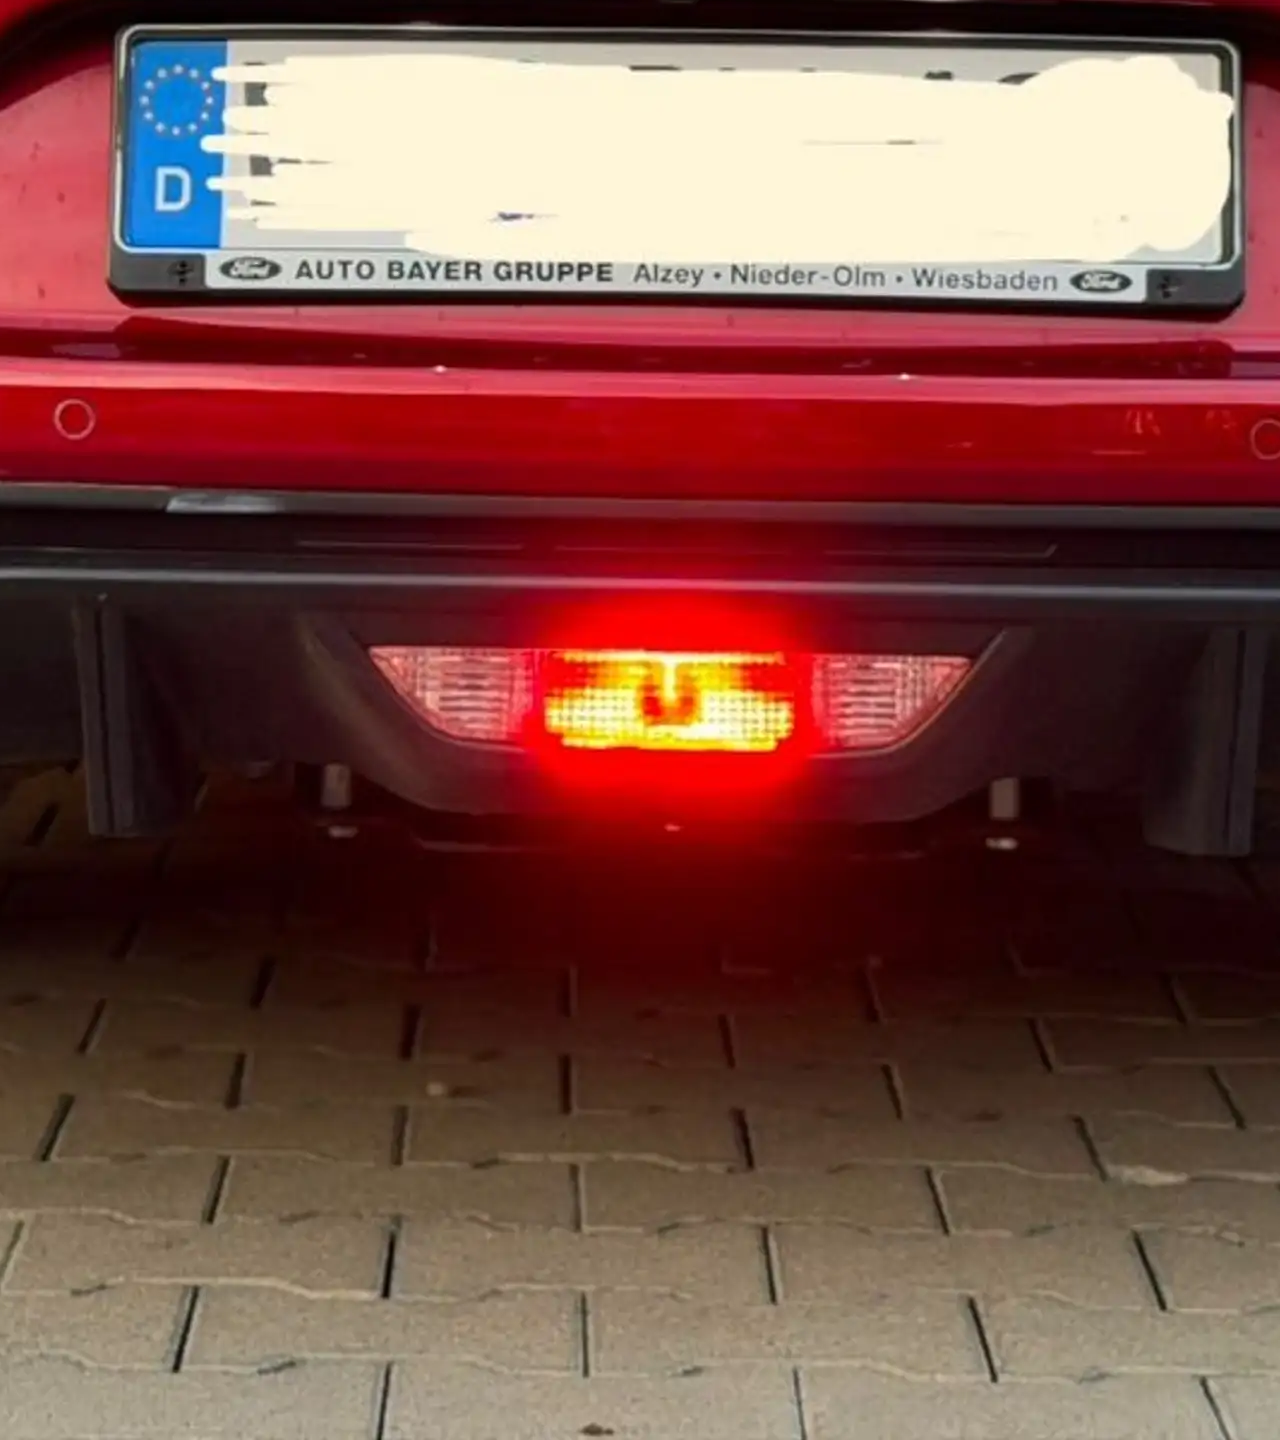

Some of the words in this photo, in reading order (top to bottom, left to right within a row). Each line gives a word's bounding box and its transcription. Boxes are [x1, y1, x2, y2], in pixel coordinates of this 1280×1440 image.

[156, 166, 191, 212] D
[294, 260, 376, 280] AUTO
[387, 261, 483, 281] BAYER
[493, 262, 614, 282] GRUPPE
[633, 263, 704, 288] Alzey
[730, 265, 886, 287] Nieder-Olm
[910, 267, 1058, 291] Wiesbaden
